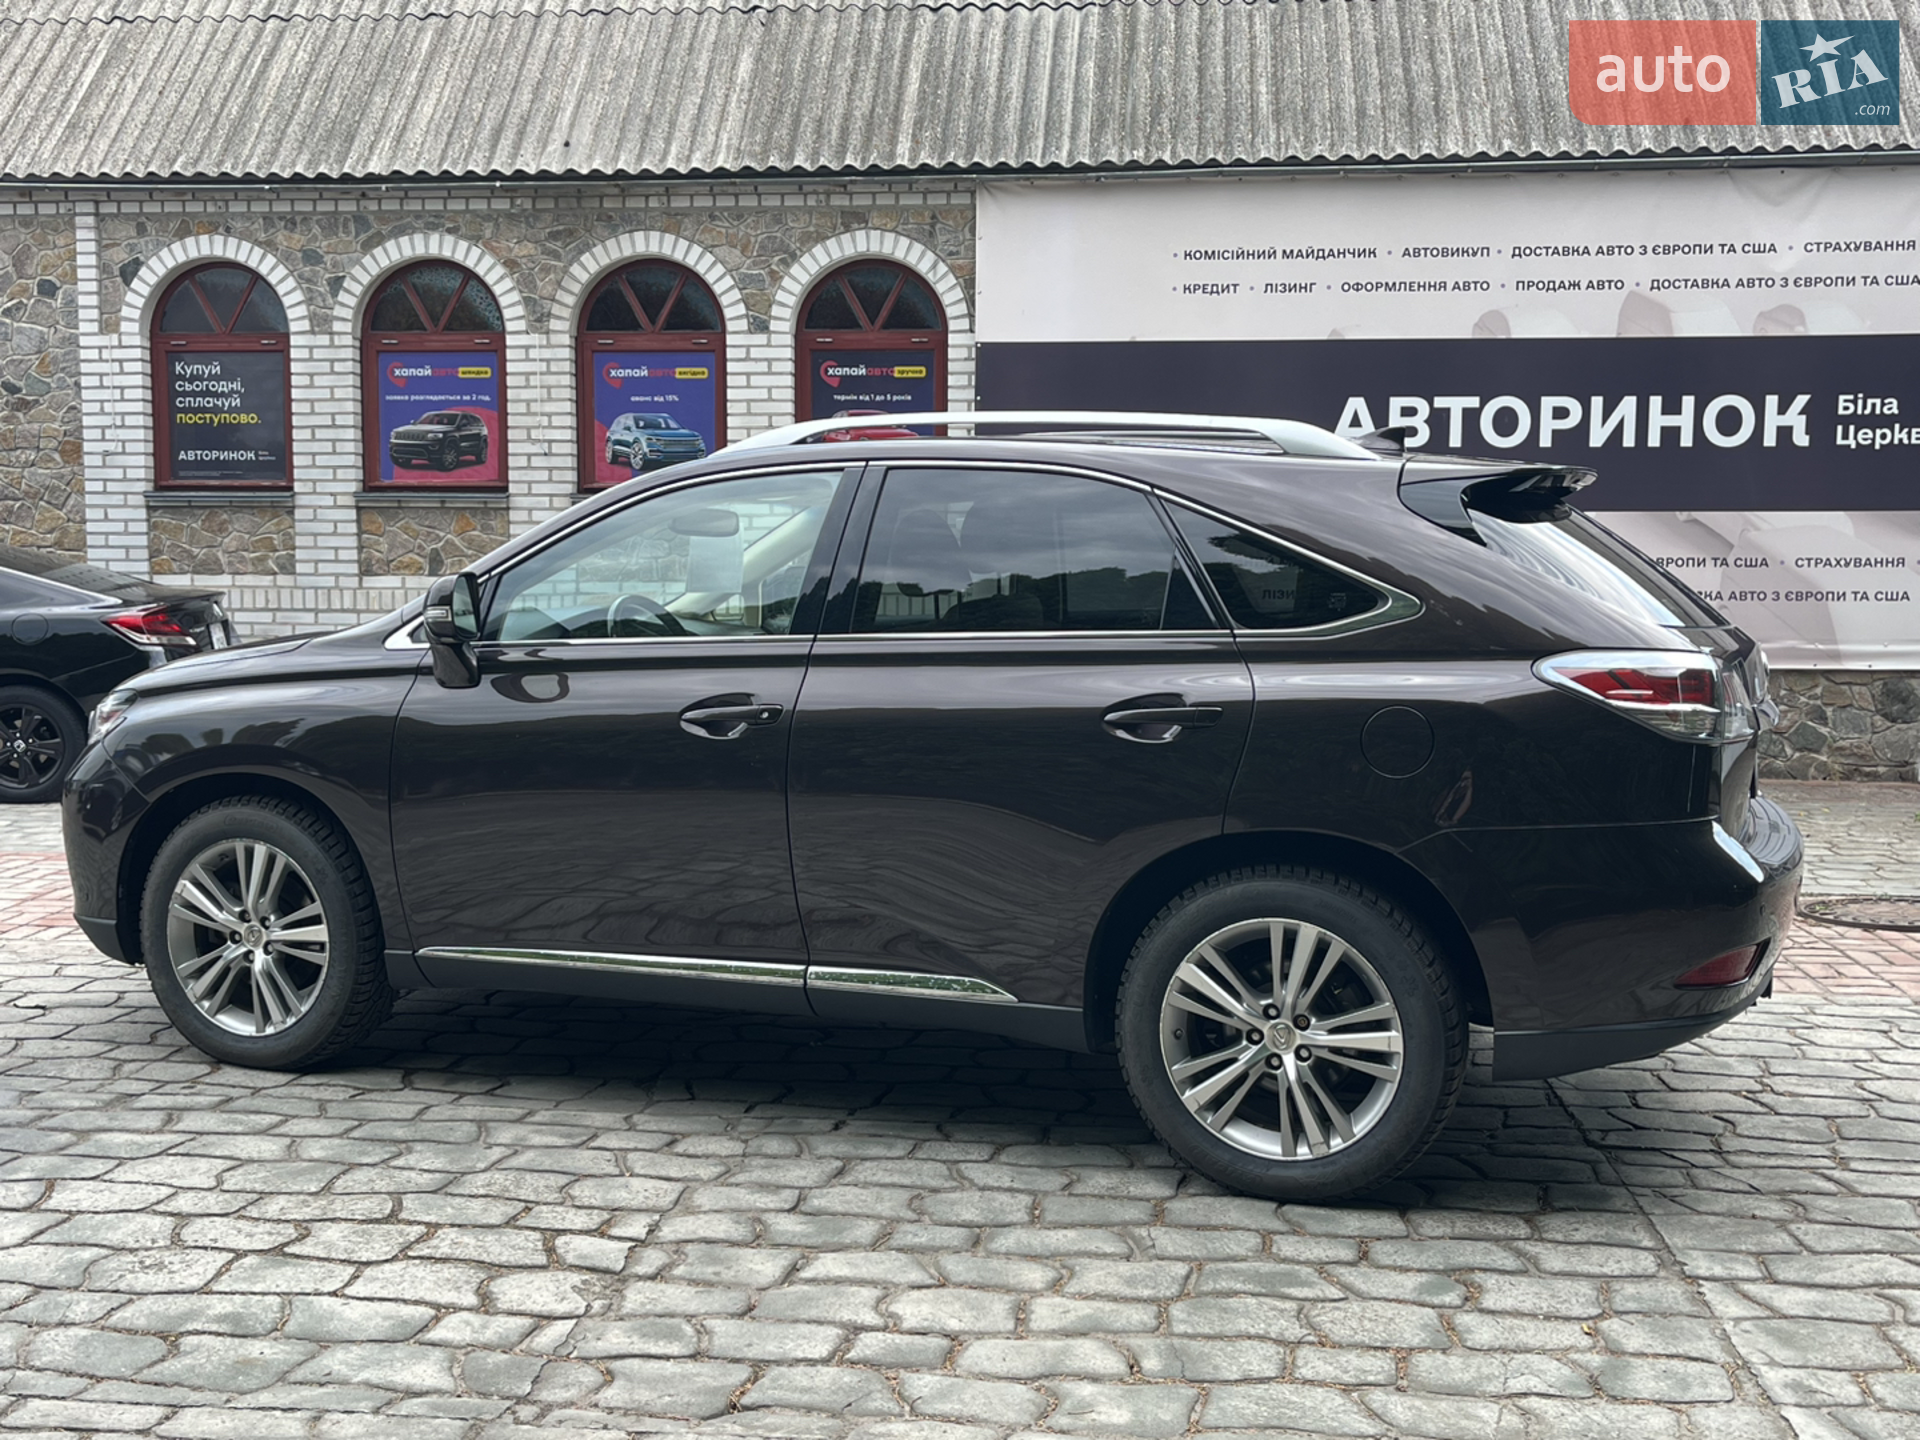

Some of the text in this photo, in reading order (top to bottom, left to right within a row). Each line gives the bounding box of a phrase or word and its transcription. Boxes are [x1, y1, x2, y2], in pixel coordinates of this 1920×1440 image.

[1183, 245, 1378, 261] КОМІСІЙНИЙ МАЙДАНЧИК
[1401, 246, 1491, 259] АВТОВИКУП
[1510, 245, 1591, 259] ДОСТАВКА
[1595, 244, 1635, 257] АВТО
[1651, 243, 1714, 256] ЄВРОПИ
[1717, 243, 1738, 255] ТА
[1741, 243, 1778, 255] США
[1803, 240, 1917, 253] СТРАХУВАННЯ
[1263, 282, 1317, 294] ЛІЗИНГ
[1340, 280, 1491, 293] ОФОРМЛЕННЯ АВТО
[1516, 279, 1625, 293] ПРОДАЖ АВТО
[1649, 278, 1731, 292] ДОСТАВКА
[1734, 277, 1776, 289] АВТО
[1793, 276, 1857, 288] ЄВРОПИ
[1860, 275, 1880, 287] ТА
[1884, 274, 1920, 287] США
[1182, 283, 1240, 297] КРЕДИТ
[175, 361, 221, 378] Купуй
[175, 378, 245, 393] сьогодні,
[175, 394, 241, 410] сплачуй
[653, 394, 665, 402] від
[1837, 393, 1899, 415] Біла
[176, 413, 262, 426] поступово.
[1334, 394, 1812, 448] АВТОРИНОК
[1835, 422, 1920, 450] Церкв
[178, 450, 256, 461] АВТОРИНОК
[1656, 557, 1770, 568] ВРОПИ ТА США
[1794, 557, 1906, 569] СТРАХУВАННЯ
[1262, 589, 1295, 600] ЛІЗИ
[1728, 590, 1768, 602] АВТО
[1784, 590, 1847, 602] ЄВРОПИ
[1851, 591, 1870, 602] ТА
[1874, 590, 1911, 602] США
